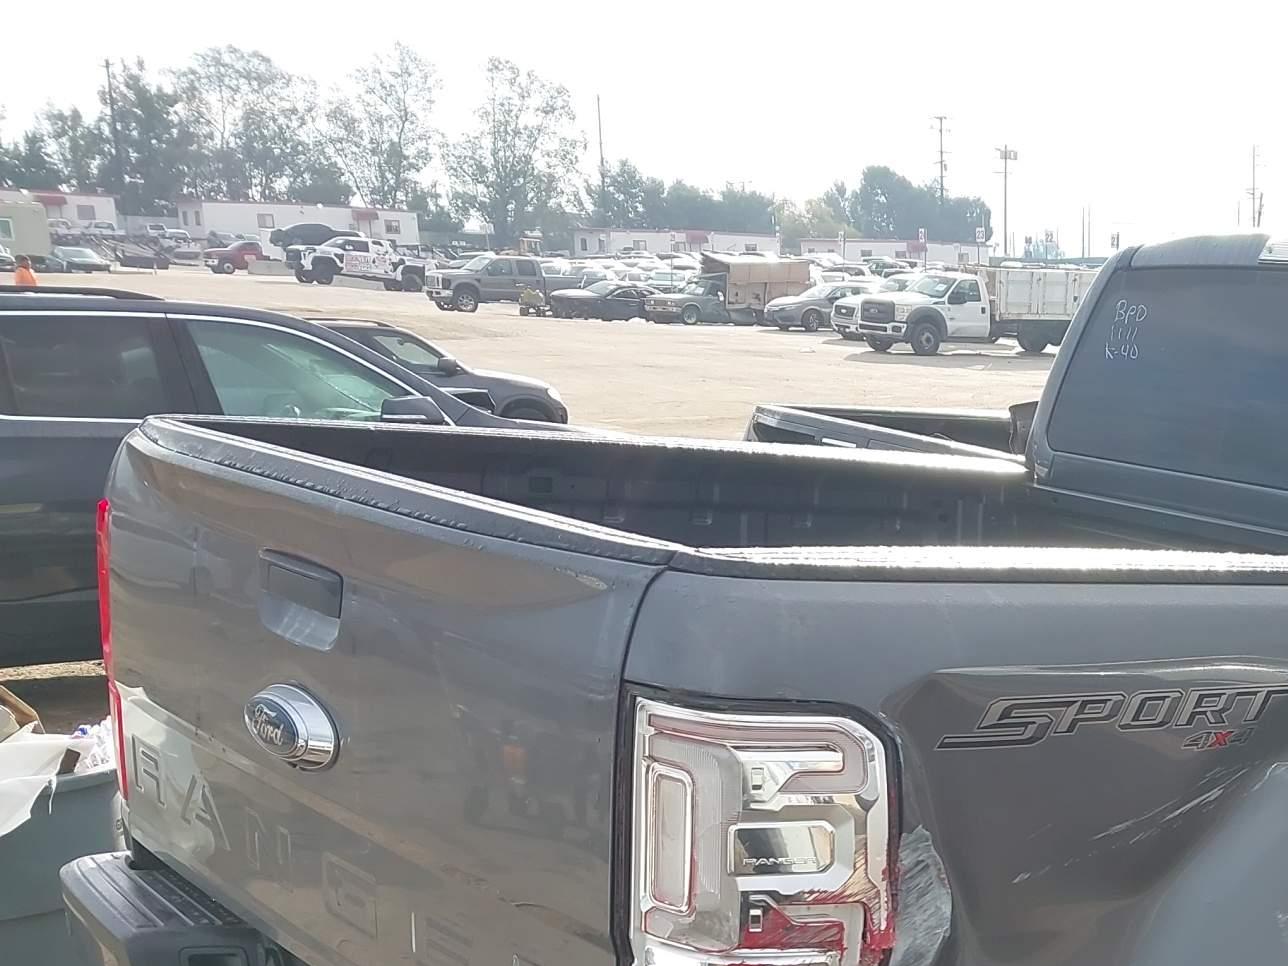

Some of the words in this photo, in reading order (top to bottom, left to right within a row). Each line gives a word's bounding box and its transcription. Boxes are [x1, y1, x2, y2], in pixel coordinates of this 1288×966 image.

[976, 229, 985, 240] 23
[252, 703, 284, 746] Ford
[742, 856, 817, 867] RANGER
